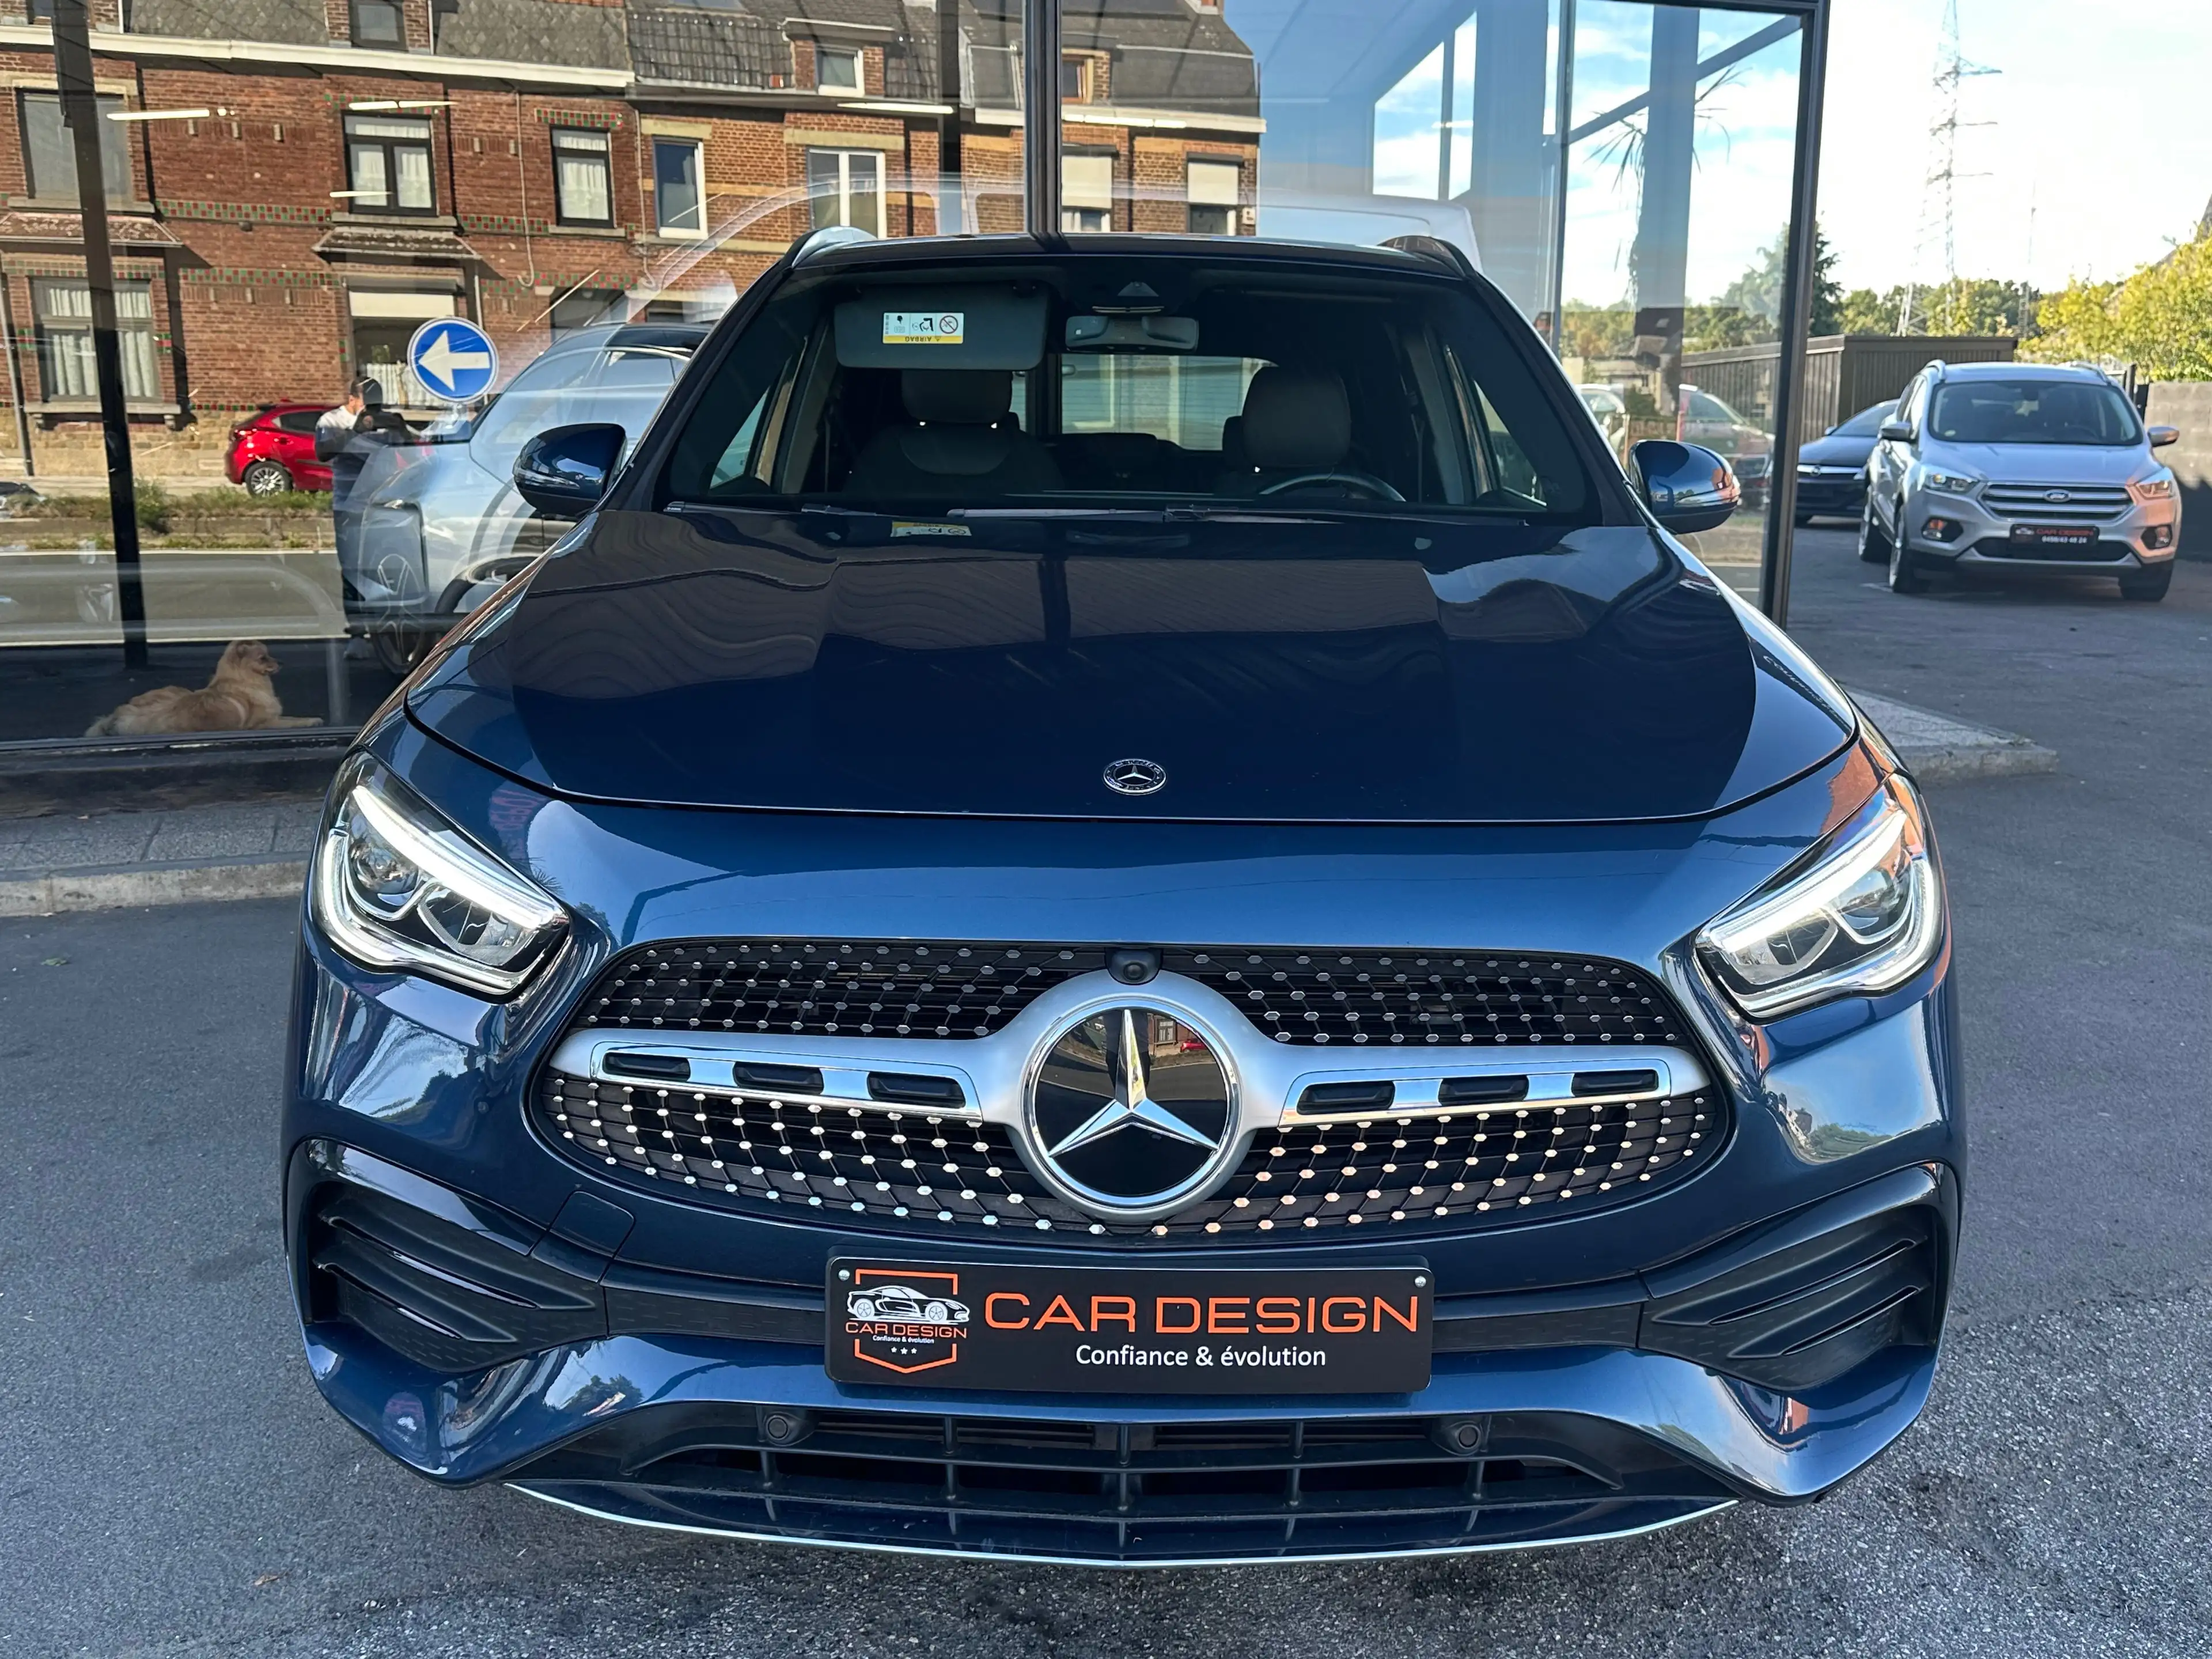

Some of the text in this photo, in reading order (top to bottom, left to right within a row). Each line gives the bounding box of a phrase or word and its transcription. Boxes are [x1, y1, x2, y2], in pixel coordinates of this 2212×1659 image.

[985, 1293, 1418, 1334] CAR DESIGN
[846, 1321, 967, 1339] CAR DESIGN
[908, 1336, 934, 1344] évolution
[1076, 1344, 1325, 1366] Confiance & évolution
